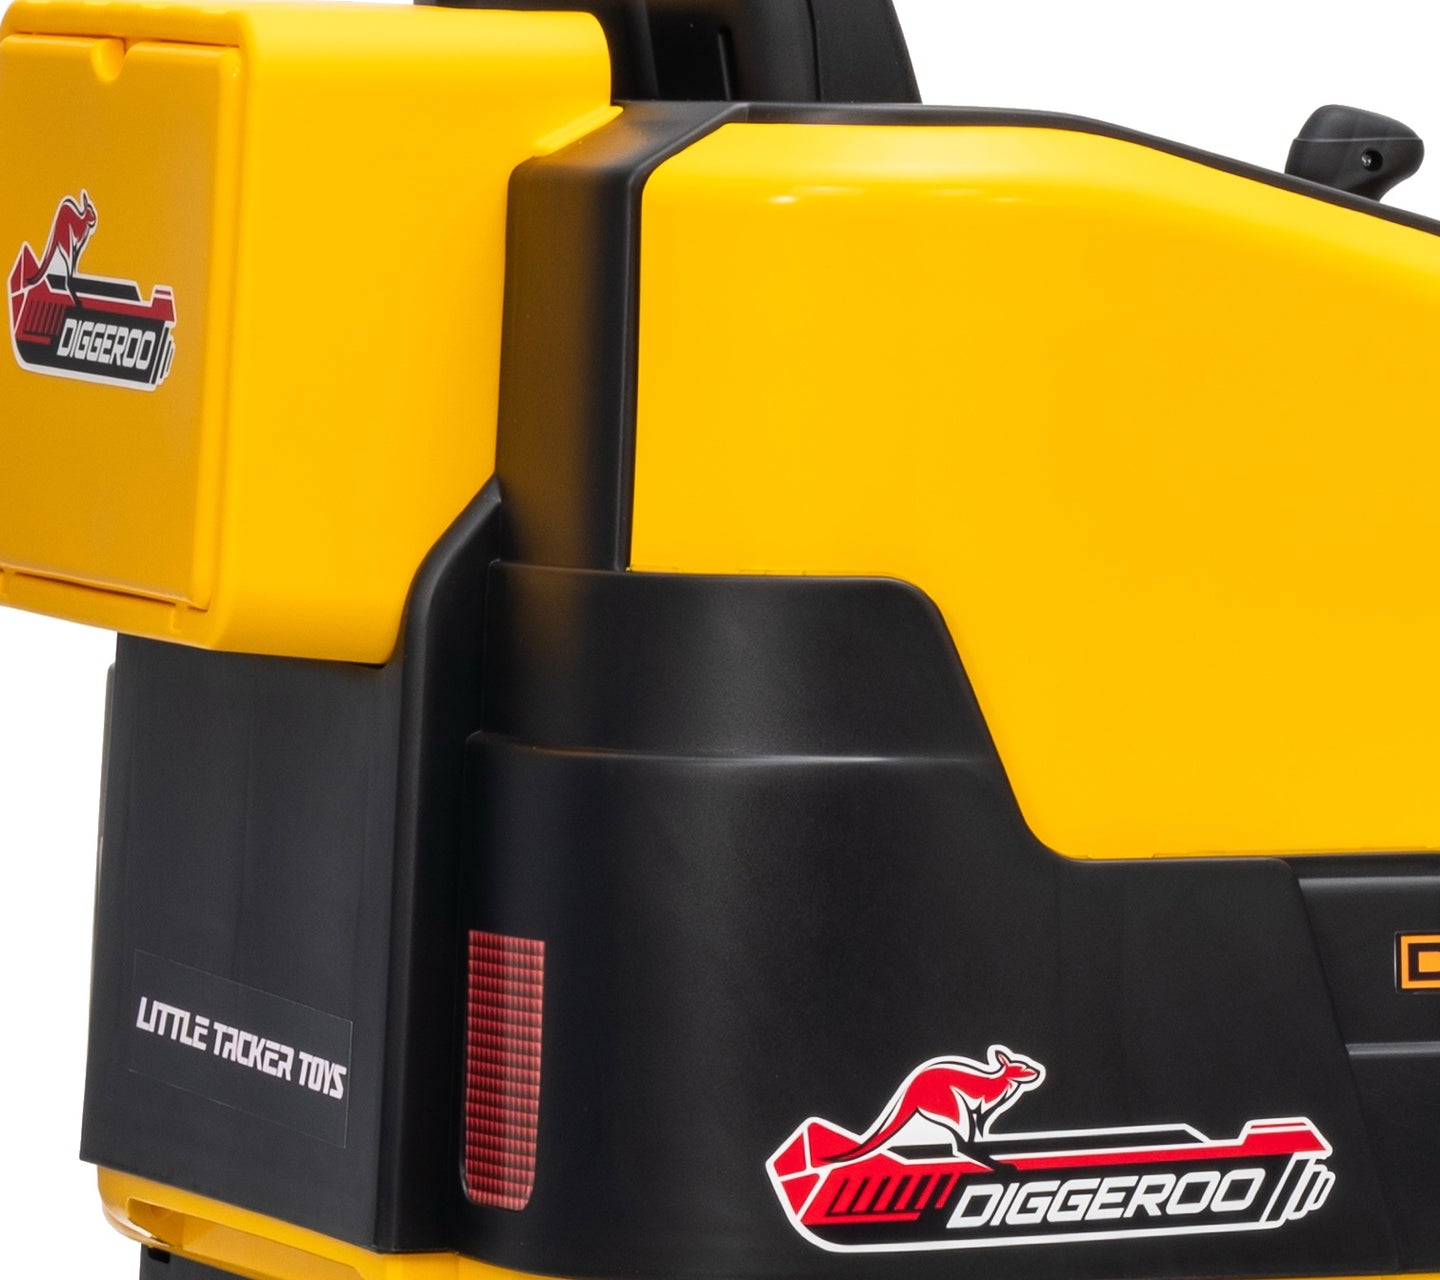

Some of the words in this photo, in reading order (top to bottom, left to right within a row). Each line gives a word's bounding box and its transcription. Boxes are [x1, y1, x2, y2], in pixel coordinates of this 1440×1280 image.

[57, 318, 156, 370] DIGGEROO
[136, 996, 210, 1051] LITTLE
[213, 1021, 295, 1081] TACKER
[298, 1051, 347, 1100] TOYS
[946, 1168, 1266, 1230] DIGGEROO
